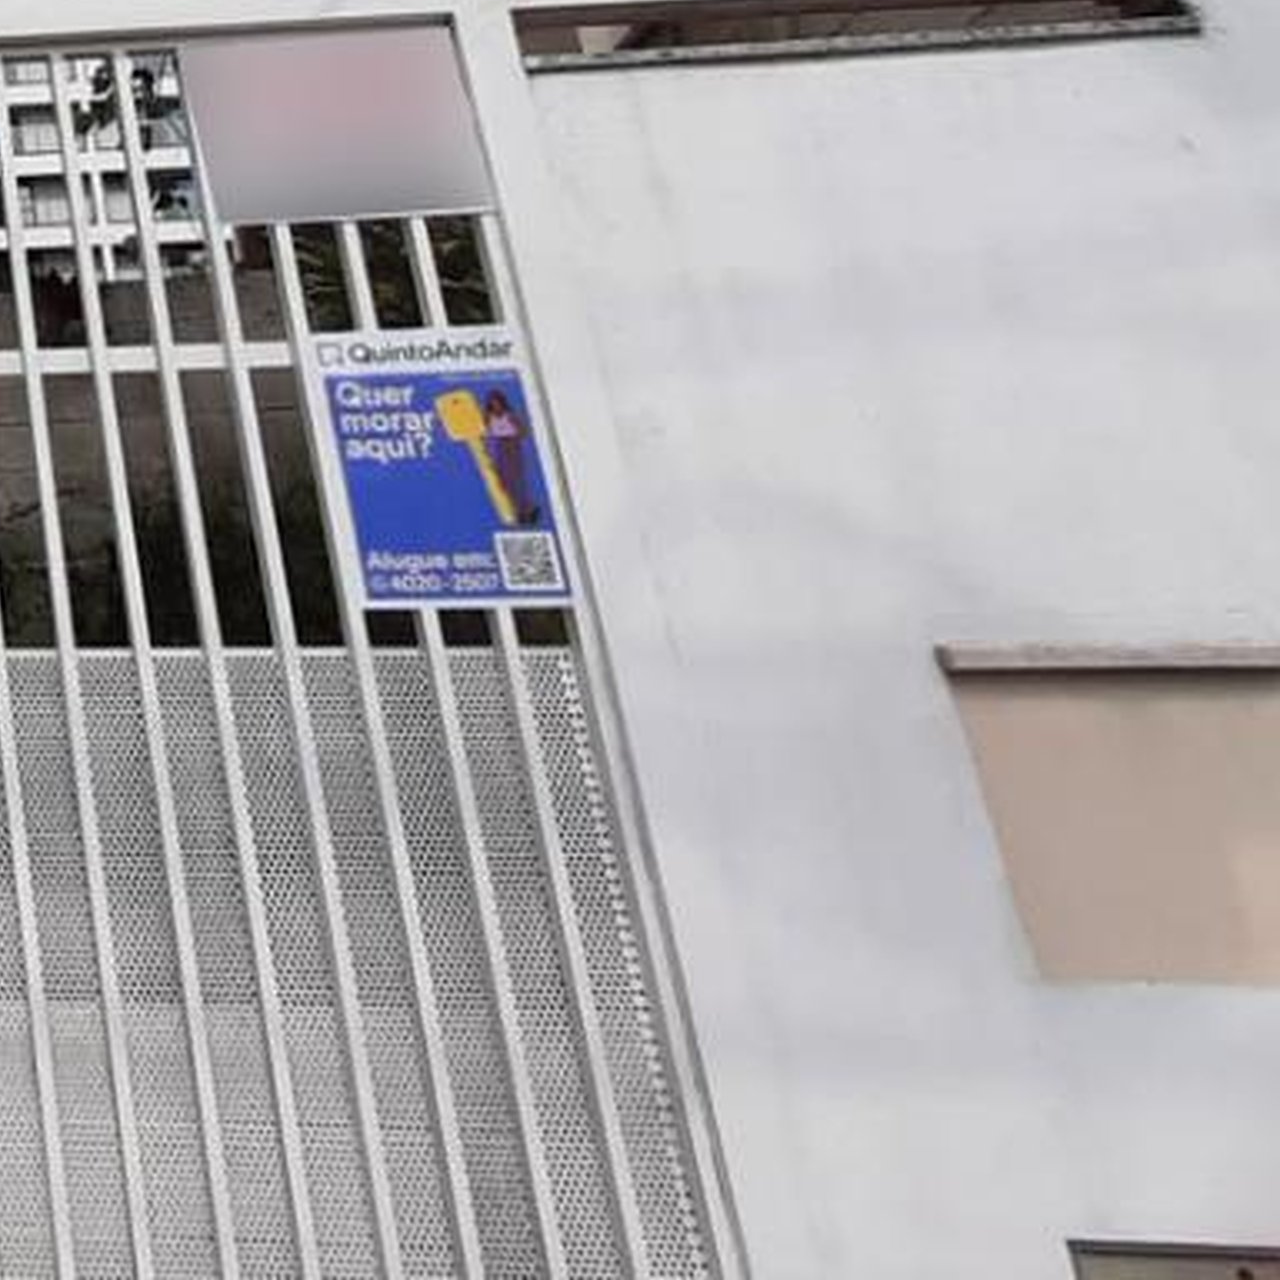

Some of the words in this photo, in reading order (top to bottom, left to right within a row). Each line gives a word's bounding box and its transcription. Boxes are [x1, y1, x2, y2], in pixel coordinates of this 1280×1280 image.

[348, 338, 513, 364] QuintoAndar
[336, 381, 415, 407] Quer
[341, 411, 434, 434] morar
[347, 435, 433, 465] aqui?
[367, 551, 448, 574] Alugue
